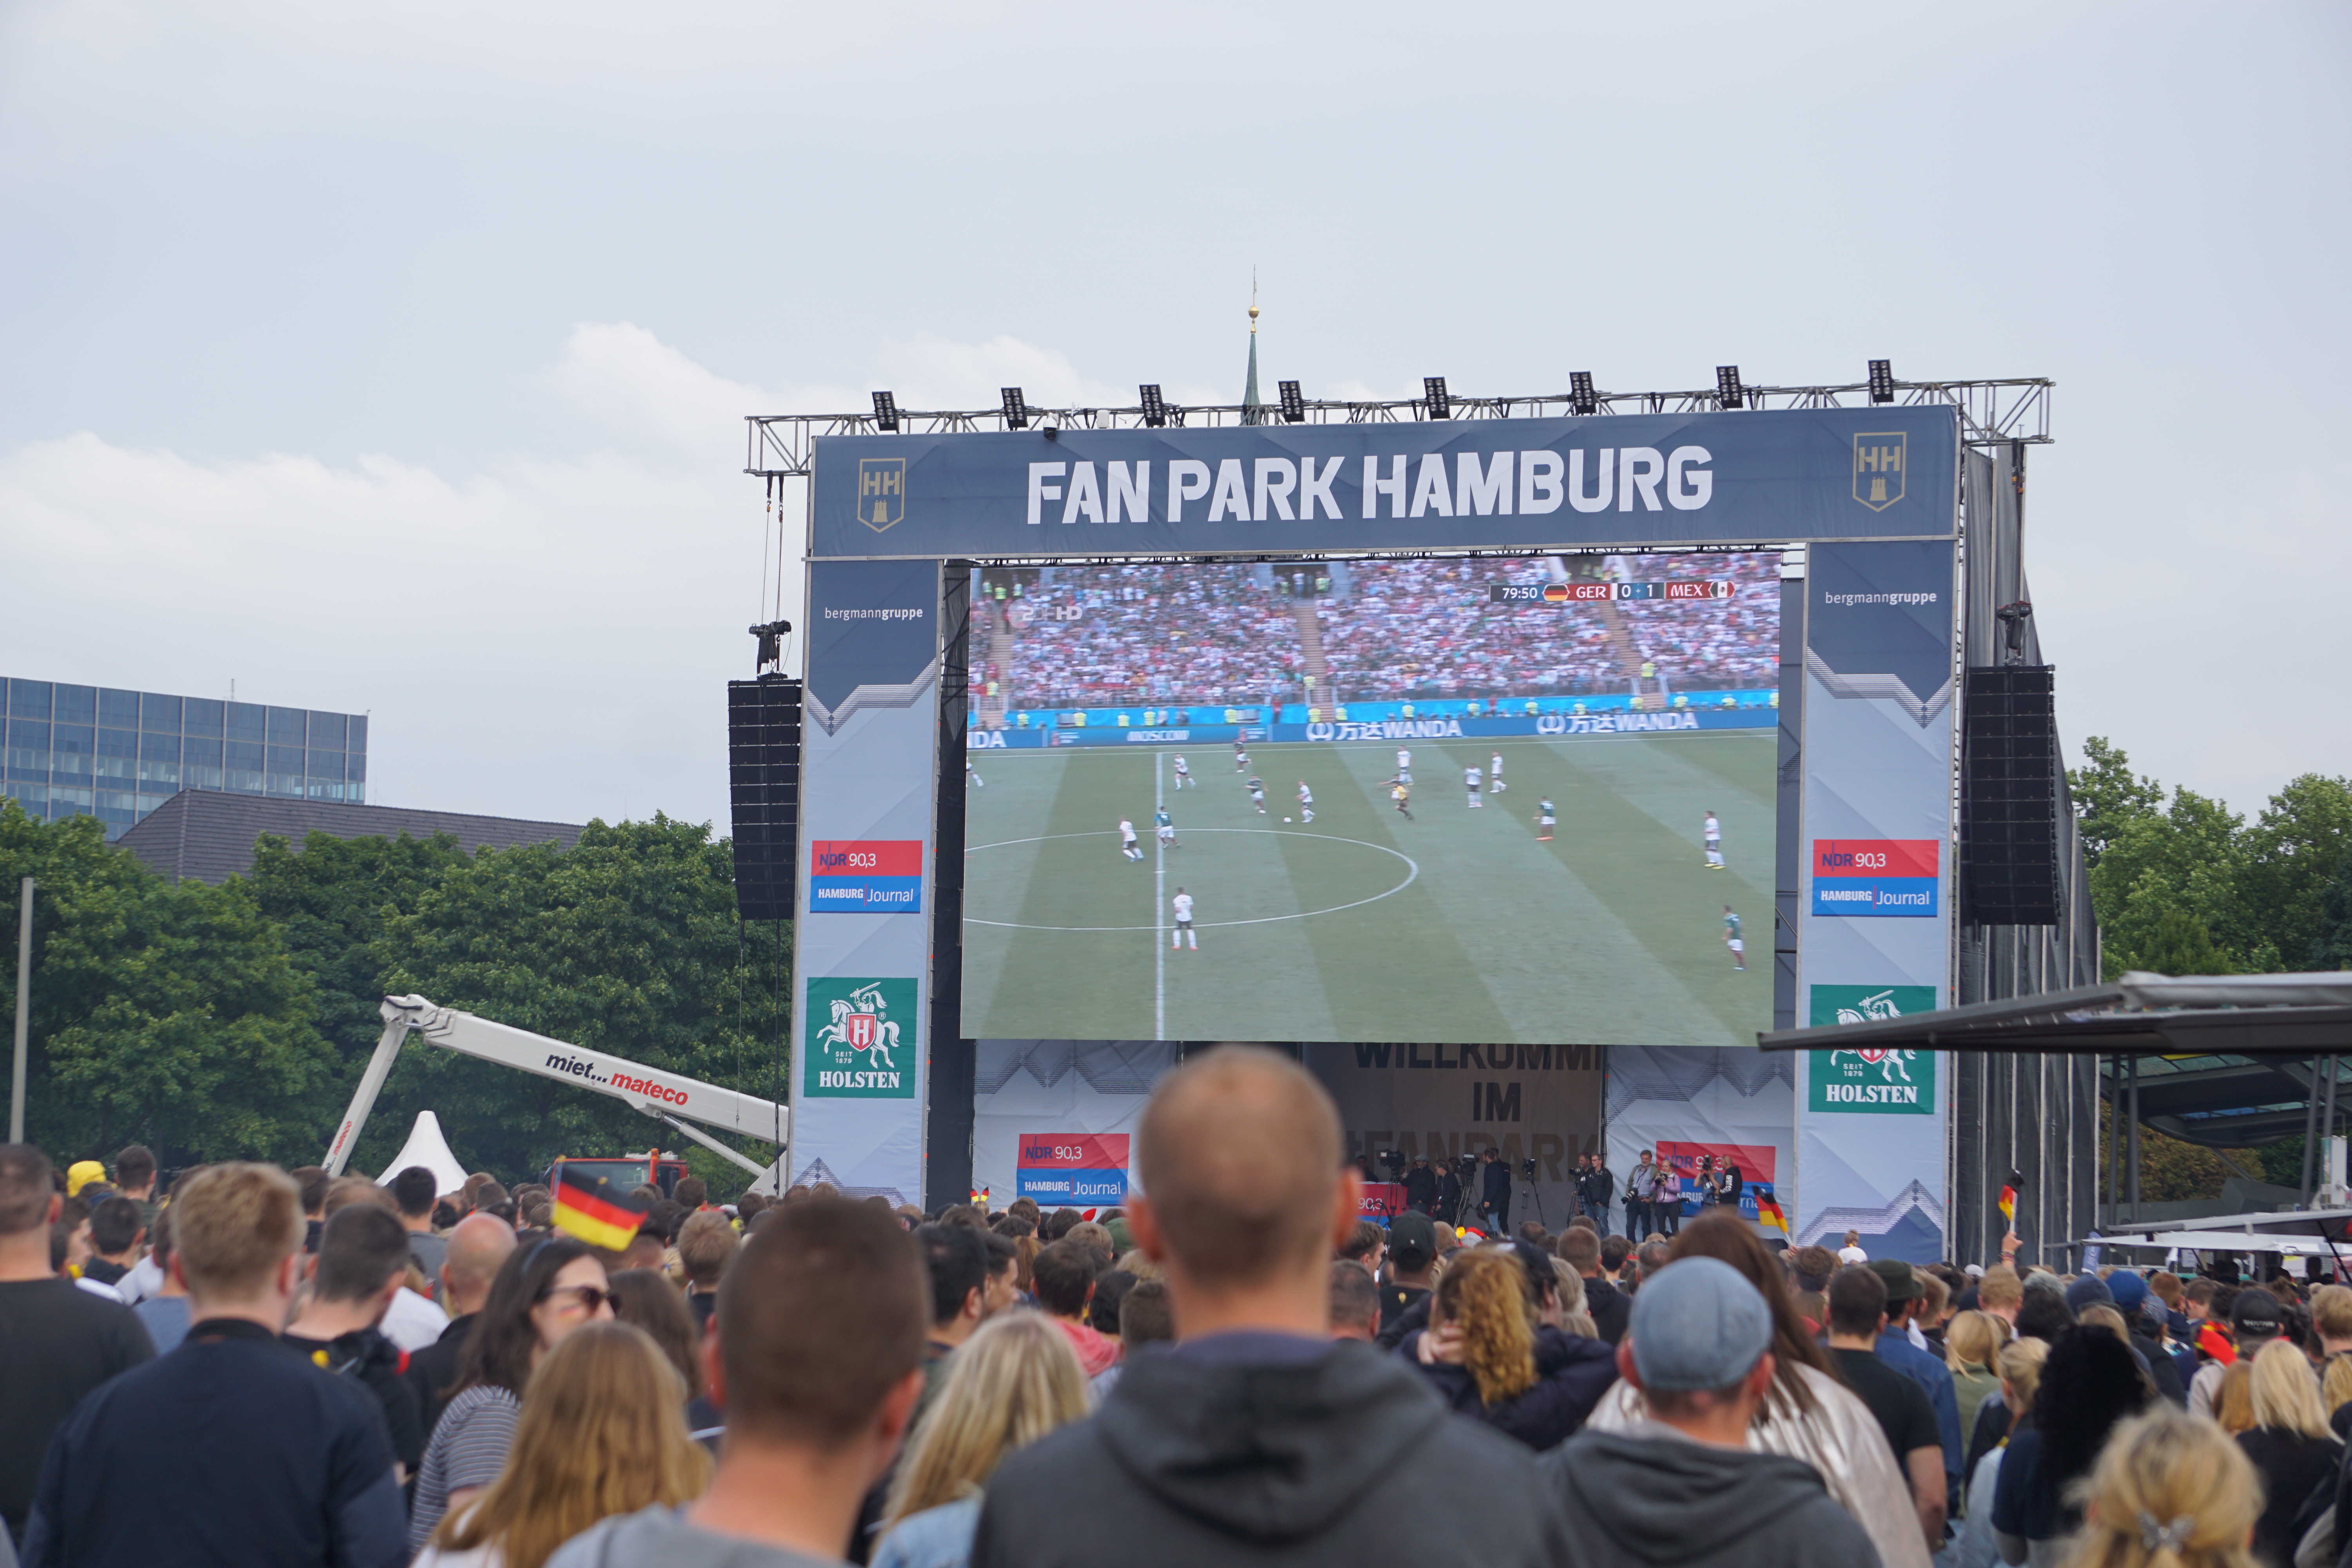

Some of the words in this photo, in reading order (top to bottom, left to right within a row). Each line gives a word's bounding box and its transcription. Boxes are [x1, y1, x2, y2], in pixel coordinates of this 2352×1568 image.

[1858, 446, 1900, 472] HH
[863, 471, 900, 495] HH
[1027, 460, 1150, 524] FAN
[1168, 456, 1345, 523] PARK
[1362, 445, 1713, 519] HAMBURG
[1502, 587, 1538, 599] 79:50
[1575, 586, 1606, 599] GER
[1621, 584, 1631, 597] 0
[1647, 584, 1653, 597] 1
[1670, 584, 1703, 597] MEX
[1825, 591, 1937, 606] bergmanngruppe
[825, 607, 923, 621] bergmanngruppe
[1056, 606, 1083, 620] HD
[1382, 720, 1463, 739] WANDA
[1615, 712, 1700, 731] WANDA
[819, 852, 847, 867] NDR
[849, 853, 877, 868] 90,3
[1822, 851, 1853, 868] NDR
[1855, 853, 1886, 869] 90,3
[818, 888, 864, 899] HAMBURG
[867, 888, 913, 903] Journal
[1820, 890, 1872, 902] HAMBURG
[1876, 891, 1929, 905] Journal
[1354, 1043, 1600, 1070] WILLKOMM
[819, 1071, 901, 1088] HOLSTEN
[610, 1073, 688, 1105] mateco
[1826, 1084, 1918, 1104] HOLSTEN
[1473, 1082, 1521, 1122] IM
[1025, 1145, 1053, 1160] NDR
[1055, 1146, 1082, 1161] 90,3
[1024, 1181, 1070, 1192] HAMBURG
[1073, 1181, 1121, 1195] Journal
